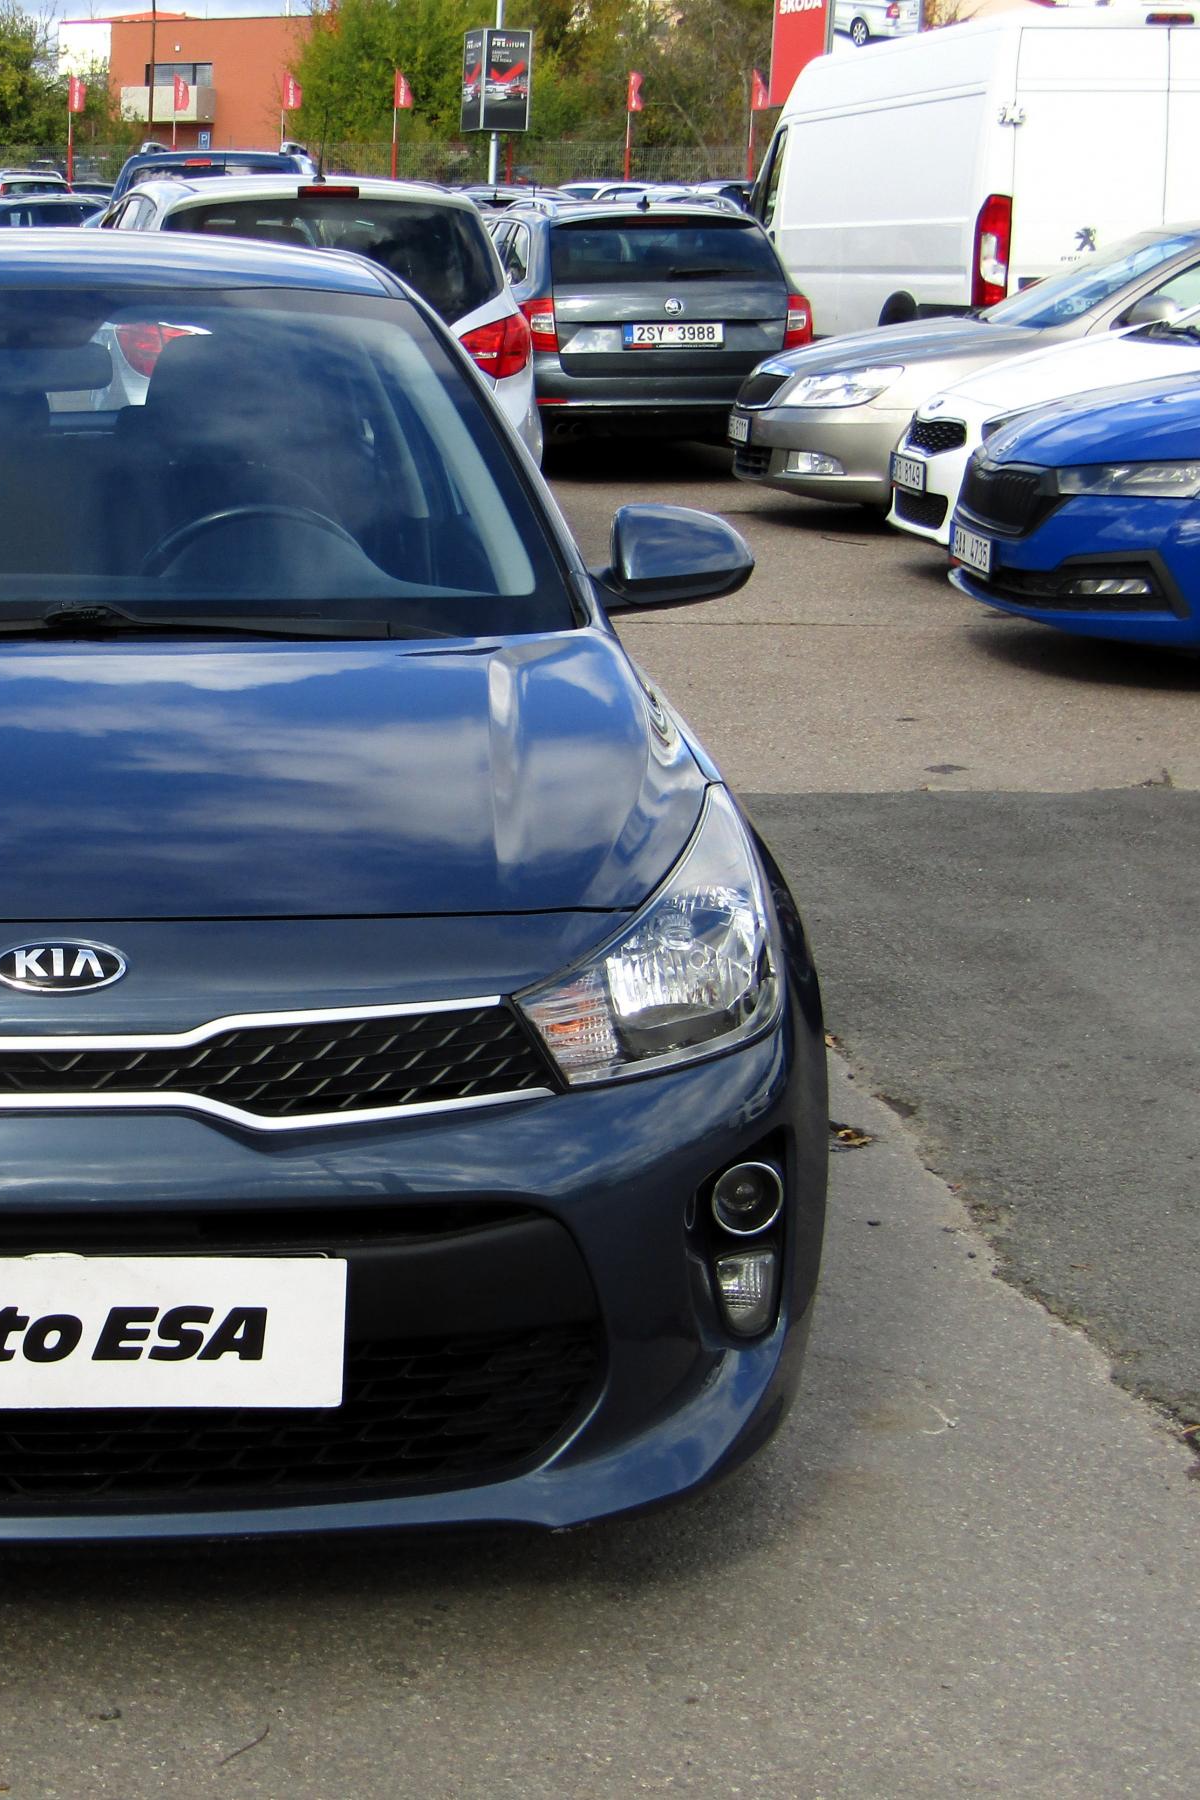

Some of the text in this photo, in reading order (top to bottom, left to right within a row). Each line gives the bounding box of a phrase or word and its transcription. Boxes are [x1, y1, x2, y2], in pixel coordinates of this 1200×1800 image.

[637, 326, 664, 341] 2SY
[678, 326, 715, 341] 3988
[905, 462, 920, 486] 8149
[13, 948, 105, 978] KIA
[91, 1305, 268, 1361] ESA
